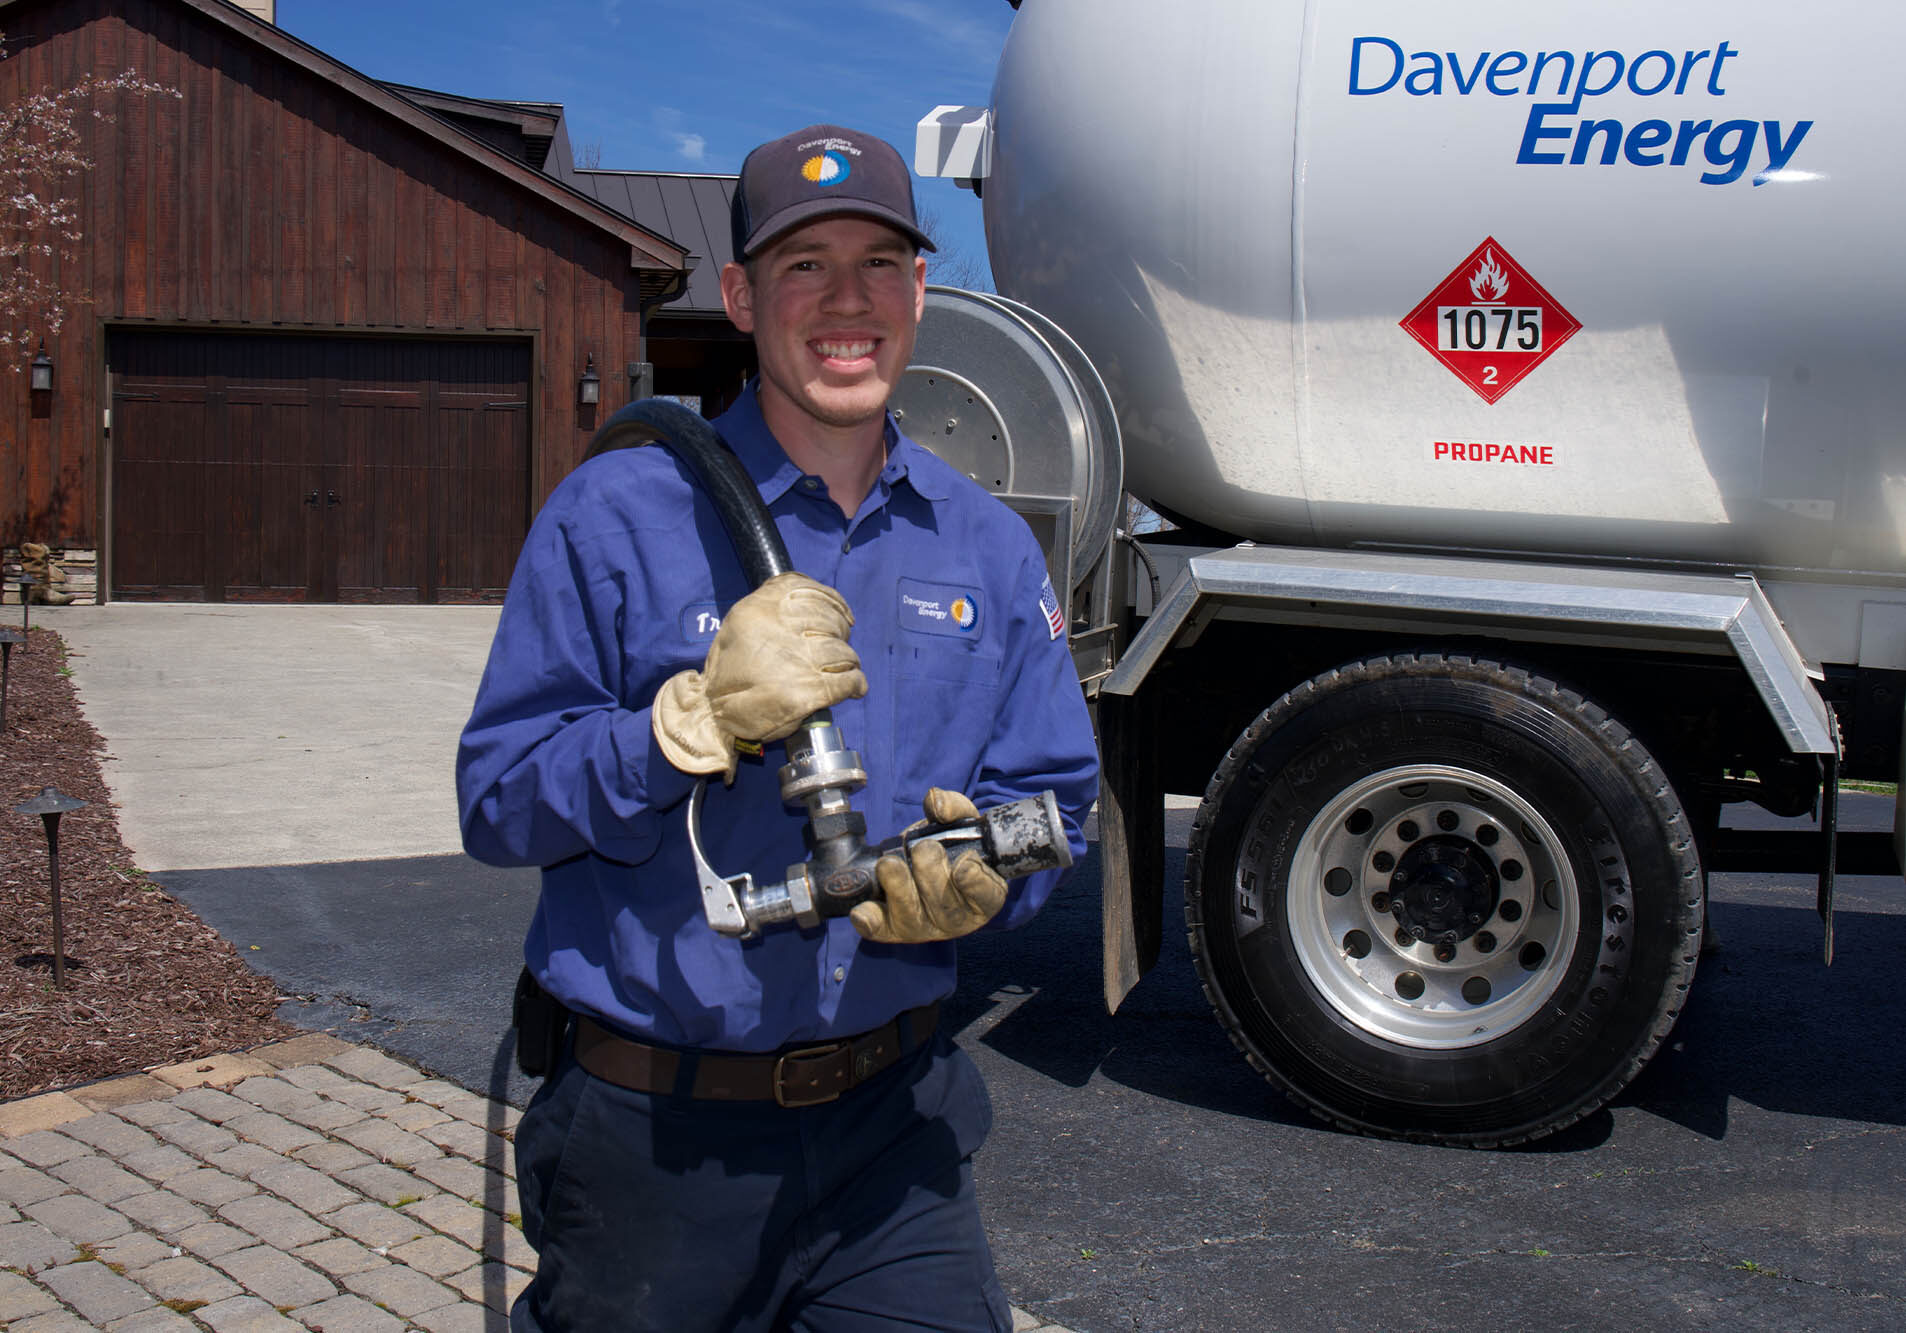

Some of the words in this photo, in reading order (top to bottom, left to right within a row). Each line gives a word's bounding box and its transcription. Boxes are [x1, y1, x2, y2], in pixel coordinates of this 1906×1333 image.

[1348, 37, 1739, 104] Davenport
[798, 138, 852, 151] Davenport
[825, 142, 862, 156] Energy
[1516, 103, 1815, 187] Energy
[1443, 308, 1540, 350] 1075
[1482, 366, 1499, 386] 2
[1433, 441, 1554, 465] PROPANE
[903, 594, 940, 610] Davenport
[697, 612, 721, 633] Tr
[918, 607, 948, 620] Energy
